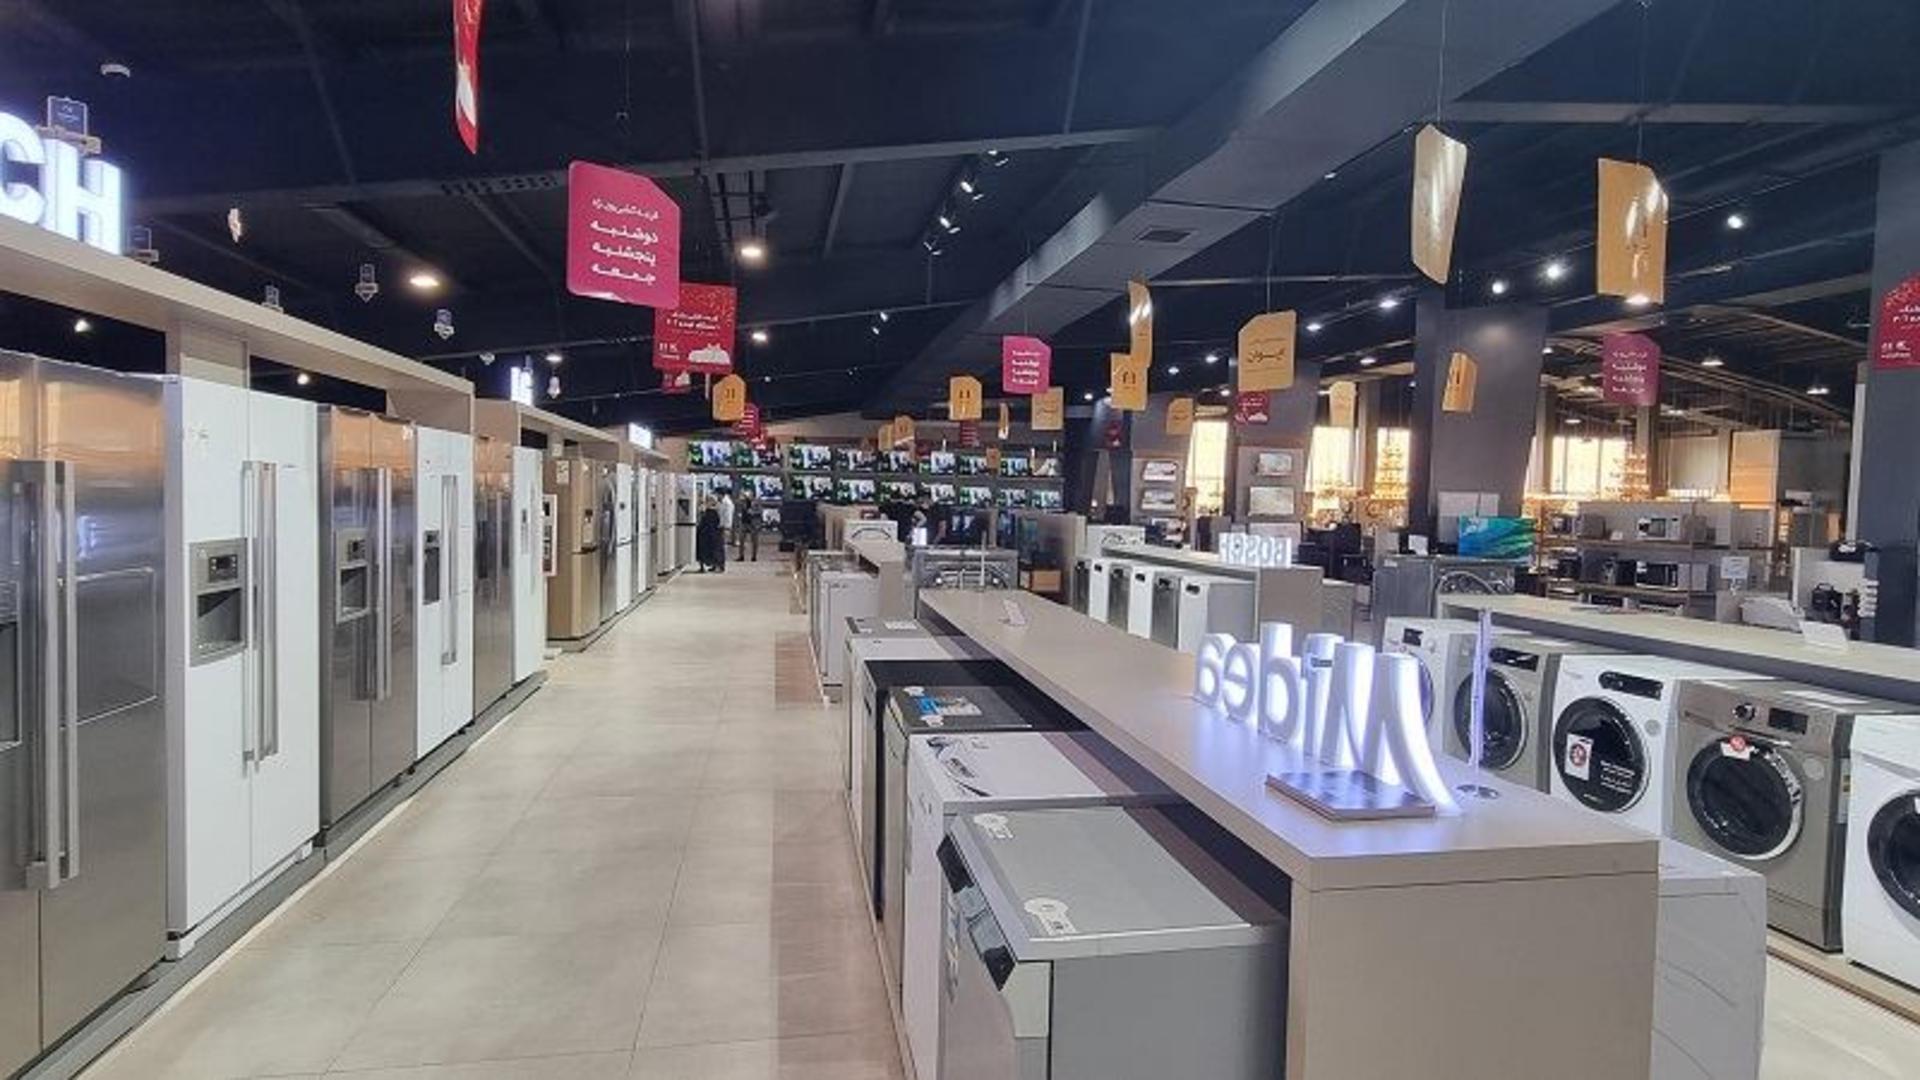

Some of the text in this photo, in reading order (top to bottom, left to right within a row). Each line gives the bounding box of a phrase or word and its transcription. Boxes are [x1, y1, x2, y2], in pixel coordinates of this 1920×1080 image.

[590, 220, 659, 246] دوشنبه
[591, 241, 657, 267] پنجشنبه
[591, 263, 657, 286] جمعه
